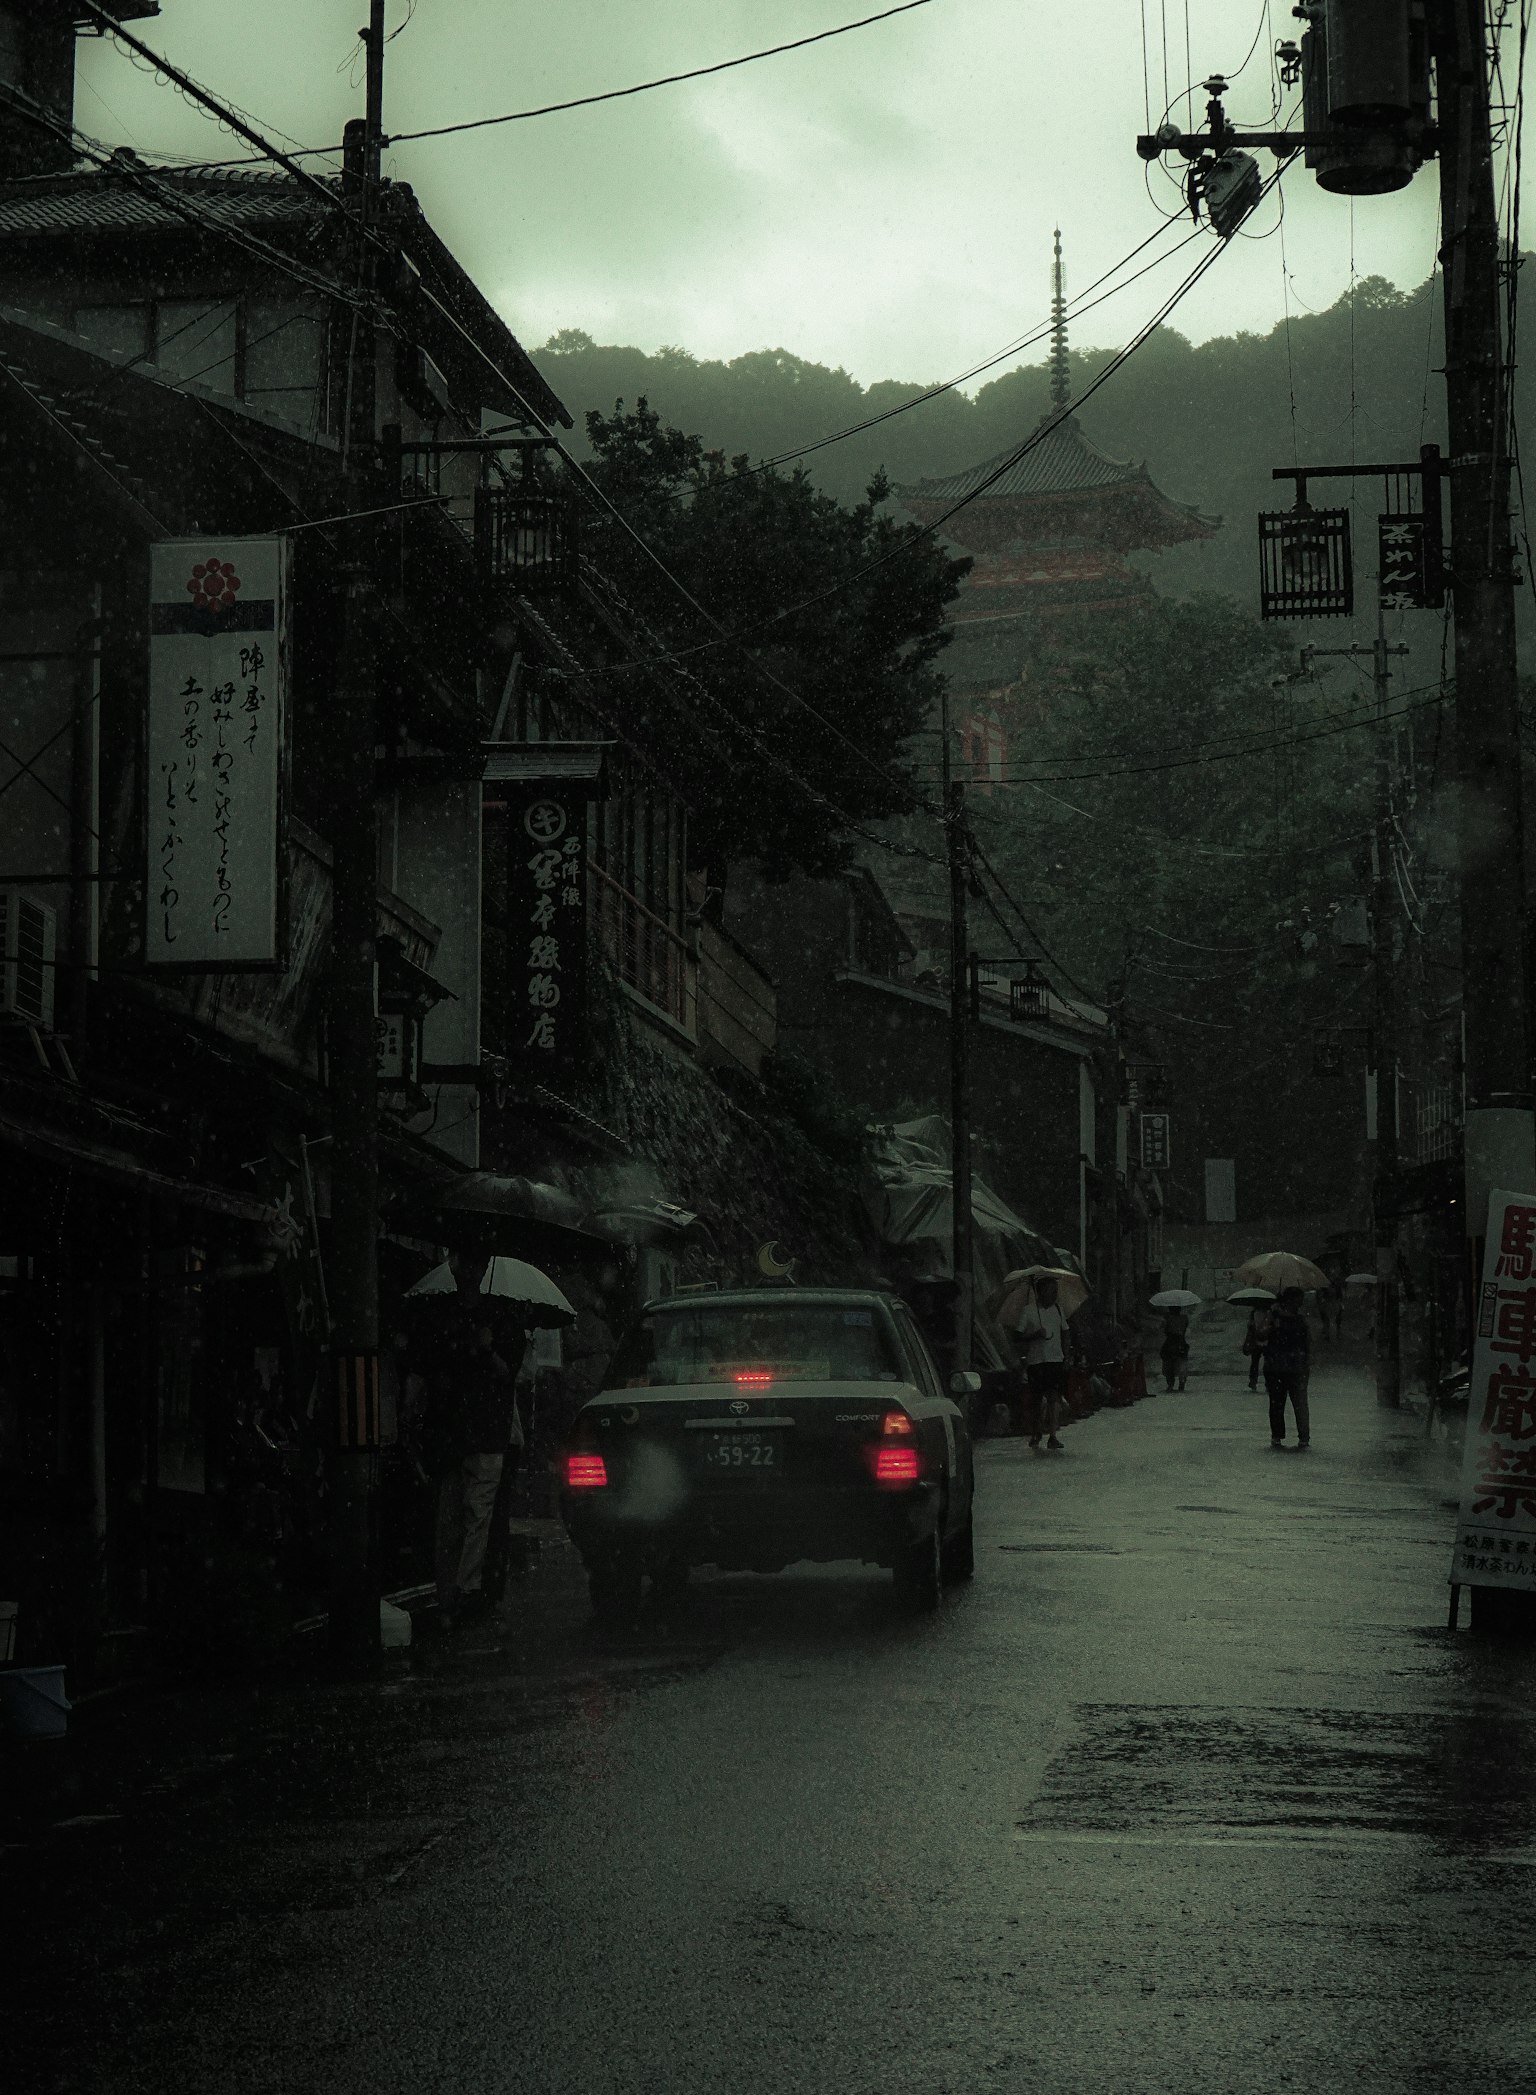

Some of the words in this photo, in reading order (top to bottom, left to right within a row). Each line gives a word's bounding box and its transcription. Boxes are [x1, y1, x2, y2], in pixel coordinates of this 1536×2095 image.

[835, 1414, 881, 1422] COMFORT
[718, 1446, 774, 1466] 59-22
[1463, 1535, 1536, 1556] 松原警察
